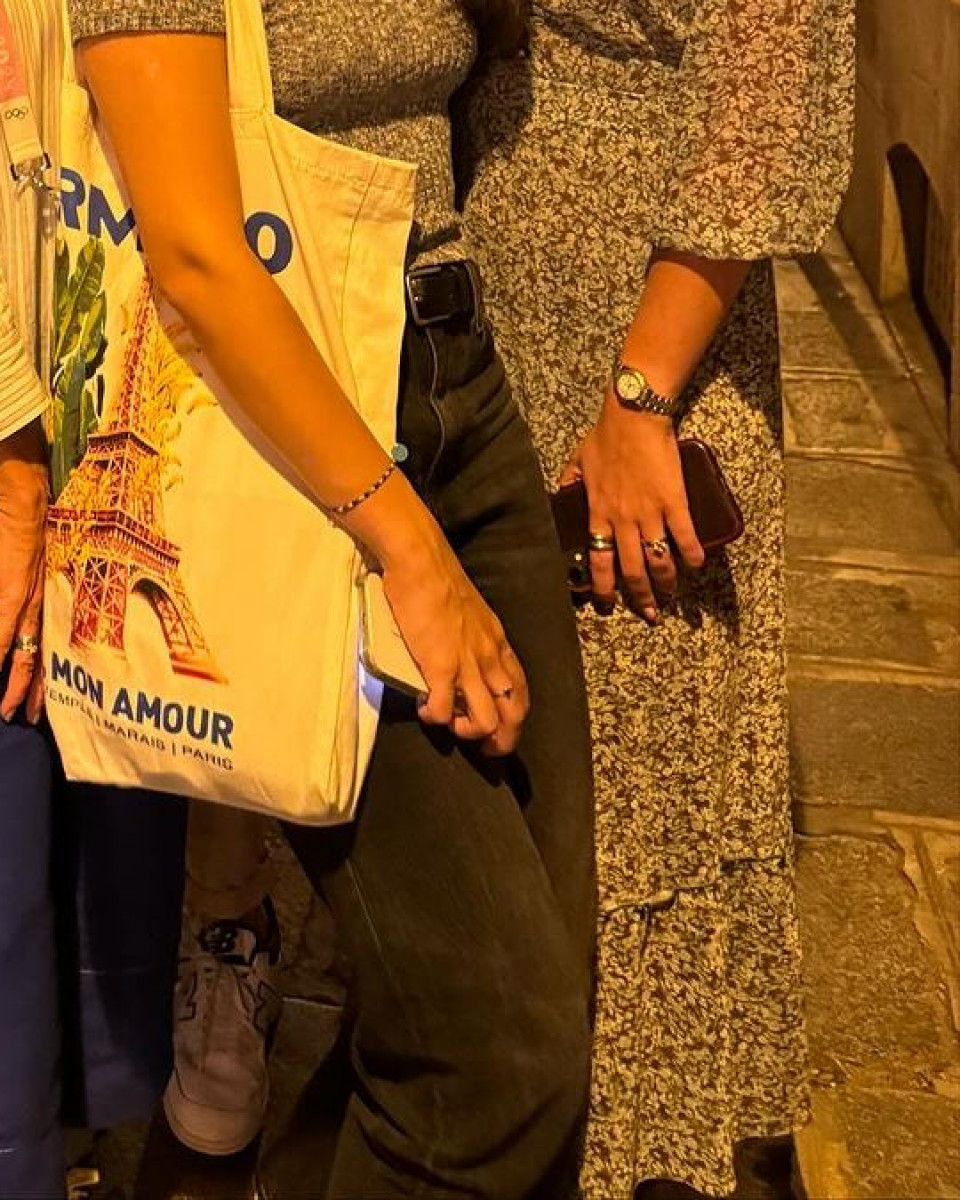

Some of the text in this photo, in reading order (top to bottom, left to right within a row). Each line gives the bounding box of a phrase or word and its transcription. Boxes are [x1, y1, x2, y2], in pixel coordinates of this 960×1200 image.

[46, 684, 234, 771] EMPLE MARAIS PARIS
[51, 652, 234, 749] MON AMOUR
